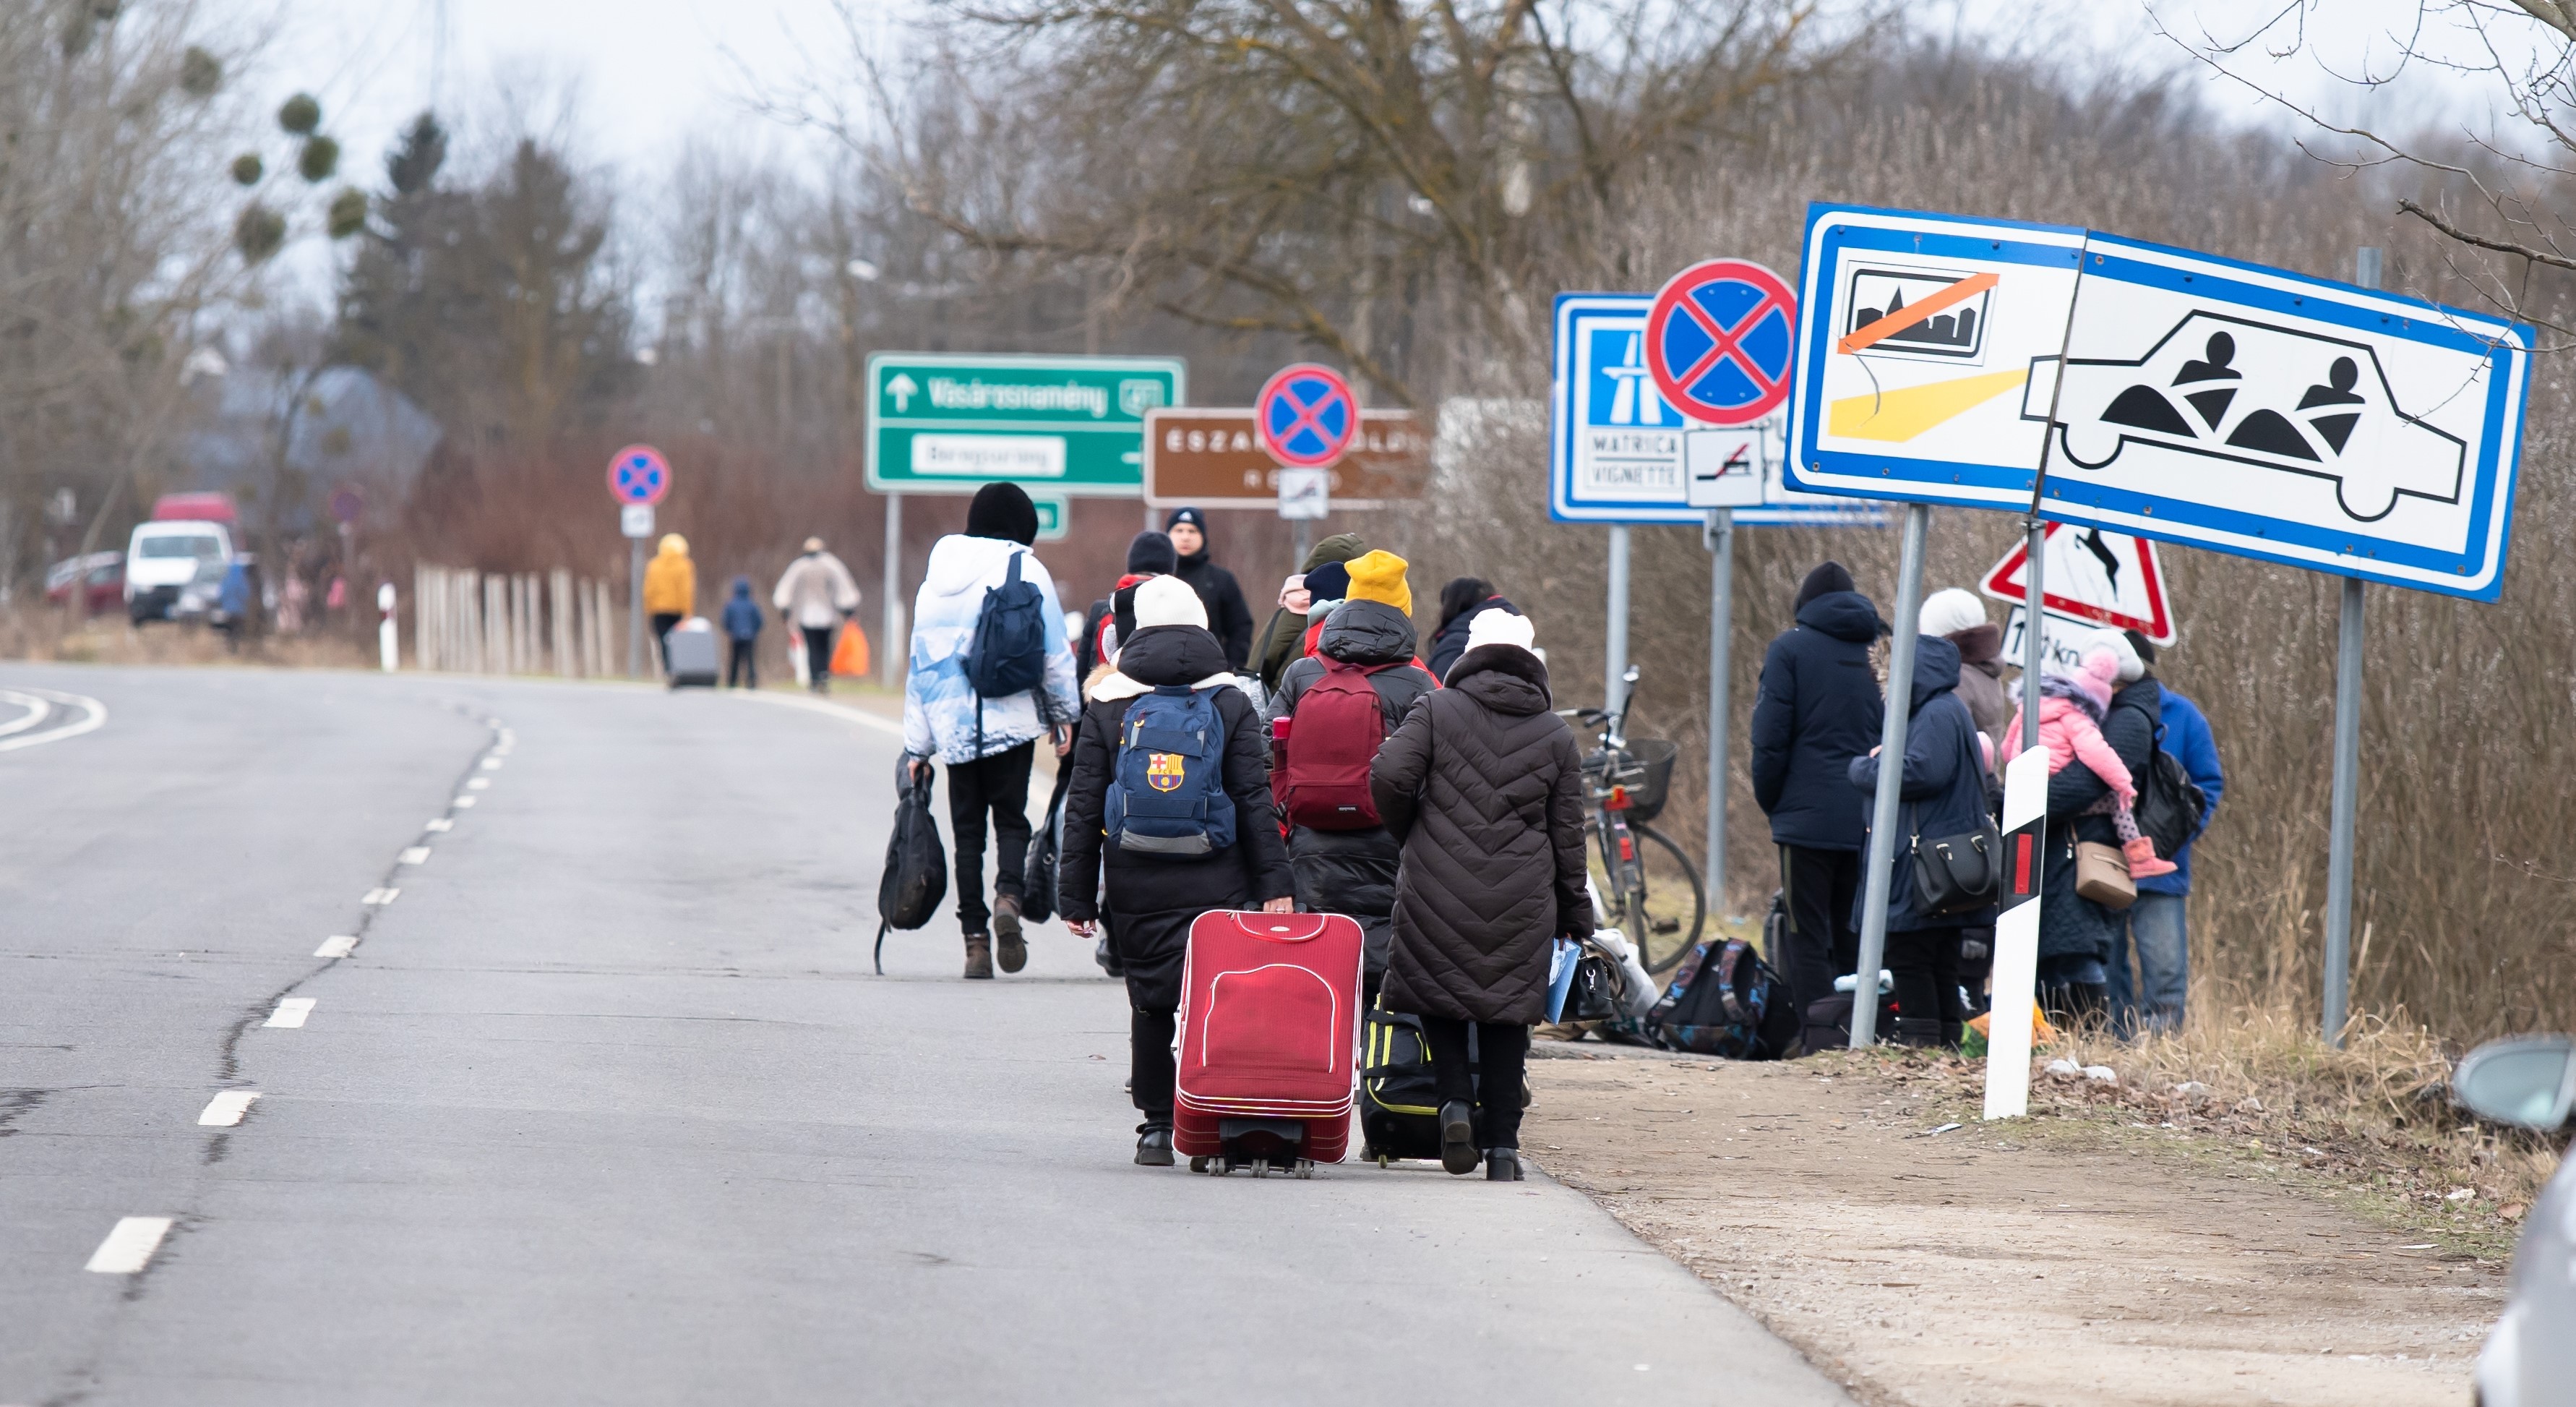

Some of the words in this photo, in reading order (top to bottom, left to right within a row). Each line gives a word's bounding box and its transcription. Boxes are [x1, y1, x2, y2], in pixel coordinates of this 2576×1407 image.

[927, 377, 1109, 418] Vásárosnamény
[1594, 436, 1678, 453] MATRICA
[1593, 466, 1675, 484] VIGNETTE
